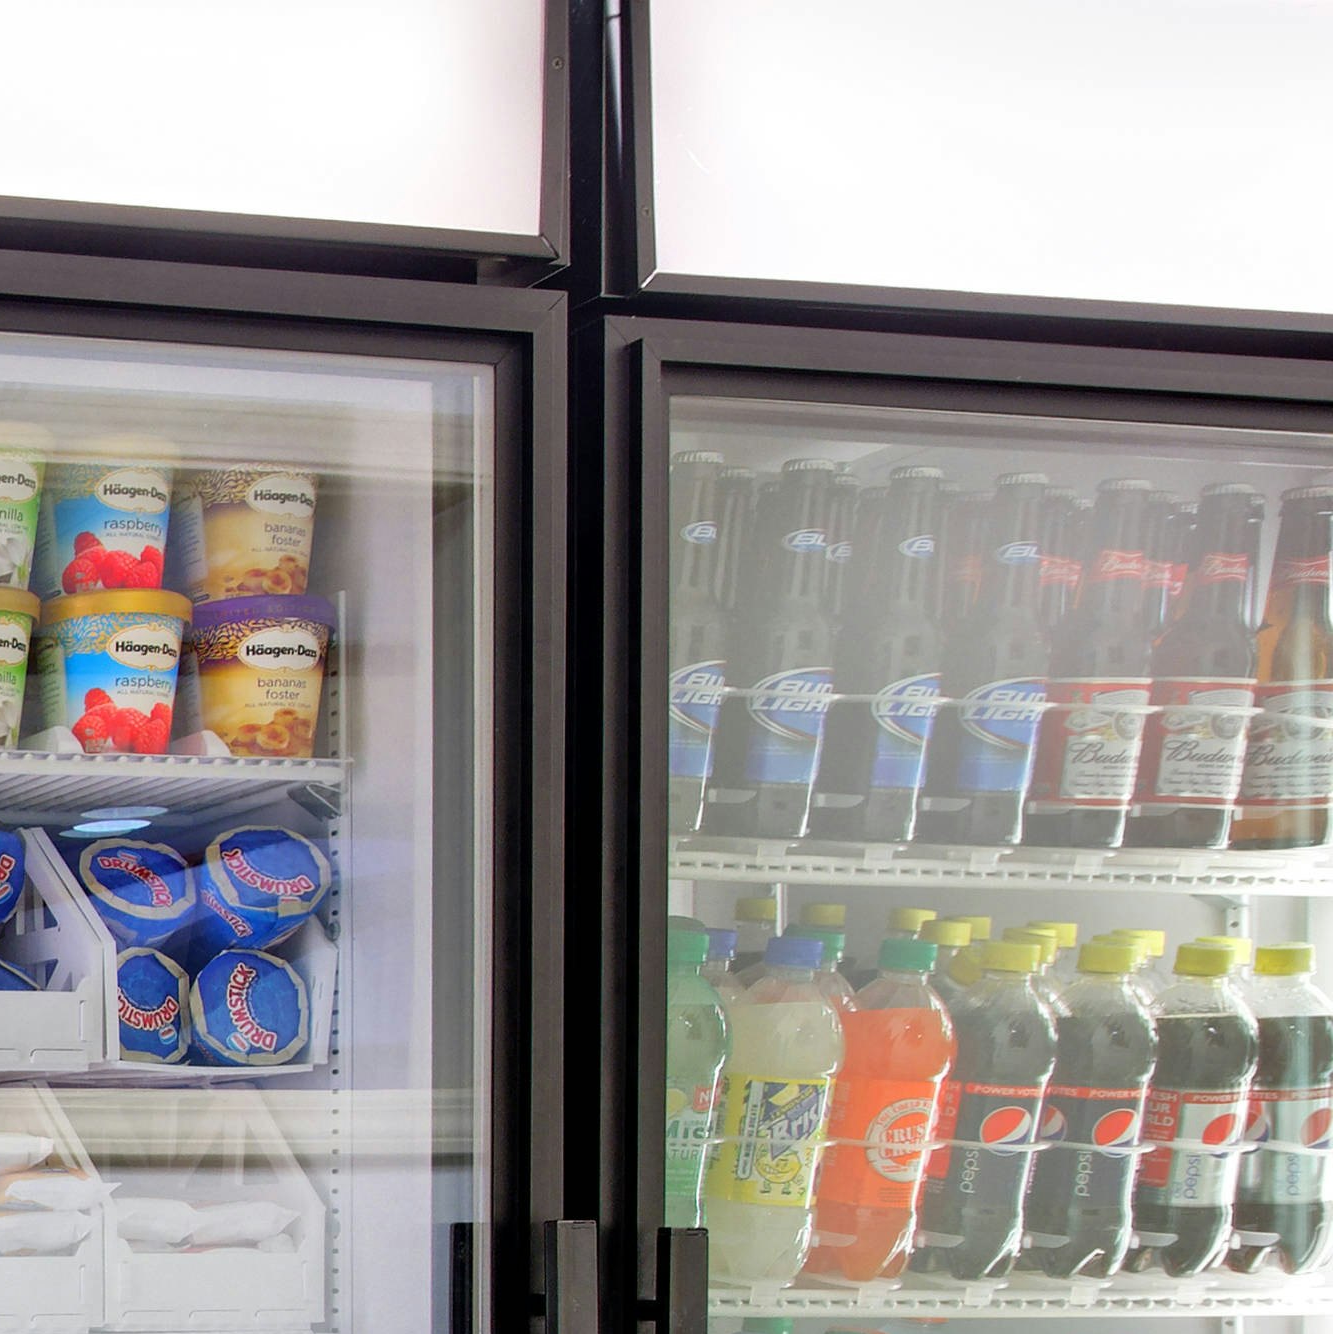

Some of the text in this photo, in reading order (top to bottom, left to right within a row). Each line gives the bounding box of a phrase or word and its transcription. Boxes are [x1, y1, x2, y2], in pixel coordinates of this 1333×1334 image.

[103, 518, 164, 536] raspberry
[264, 522, 307, 536] bananas
[271, 534, 302, 546] foster
[114, 640, 178, 658] Häagen-Dazs
[245, 643, 317, 659] Häagen-Dazs
[114, 675, 173, 692] raspberry
[257, 677, 307, 689] bananas
[265, 688, 300, 700] foster
[223, 848, 315, 896] DRUMSTICK
[99, 854, 172, 908] DRUMSTICK
[226, 962, 277, 1051] DRUMSTICK
